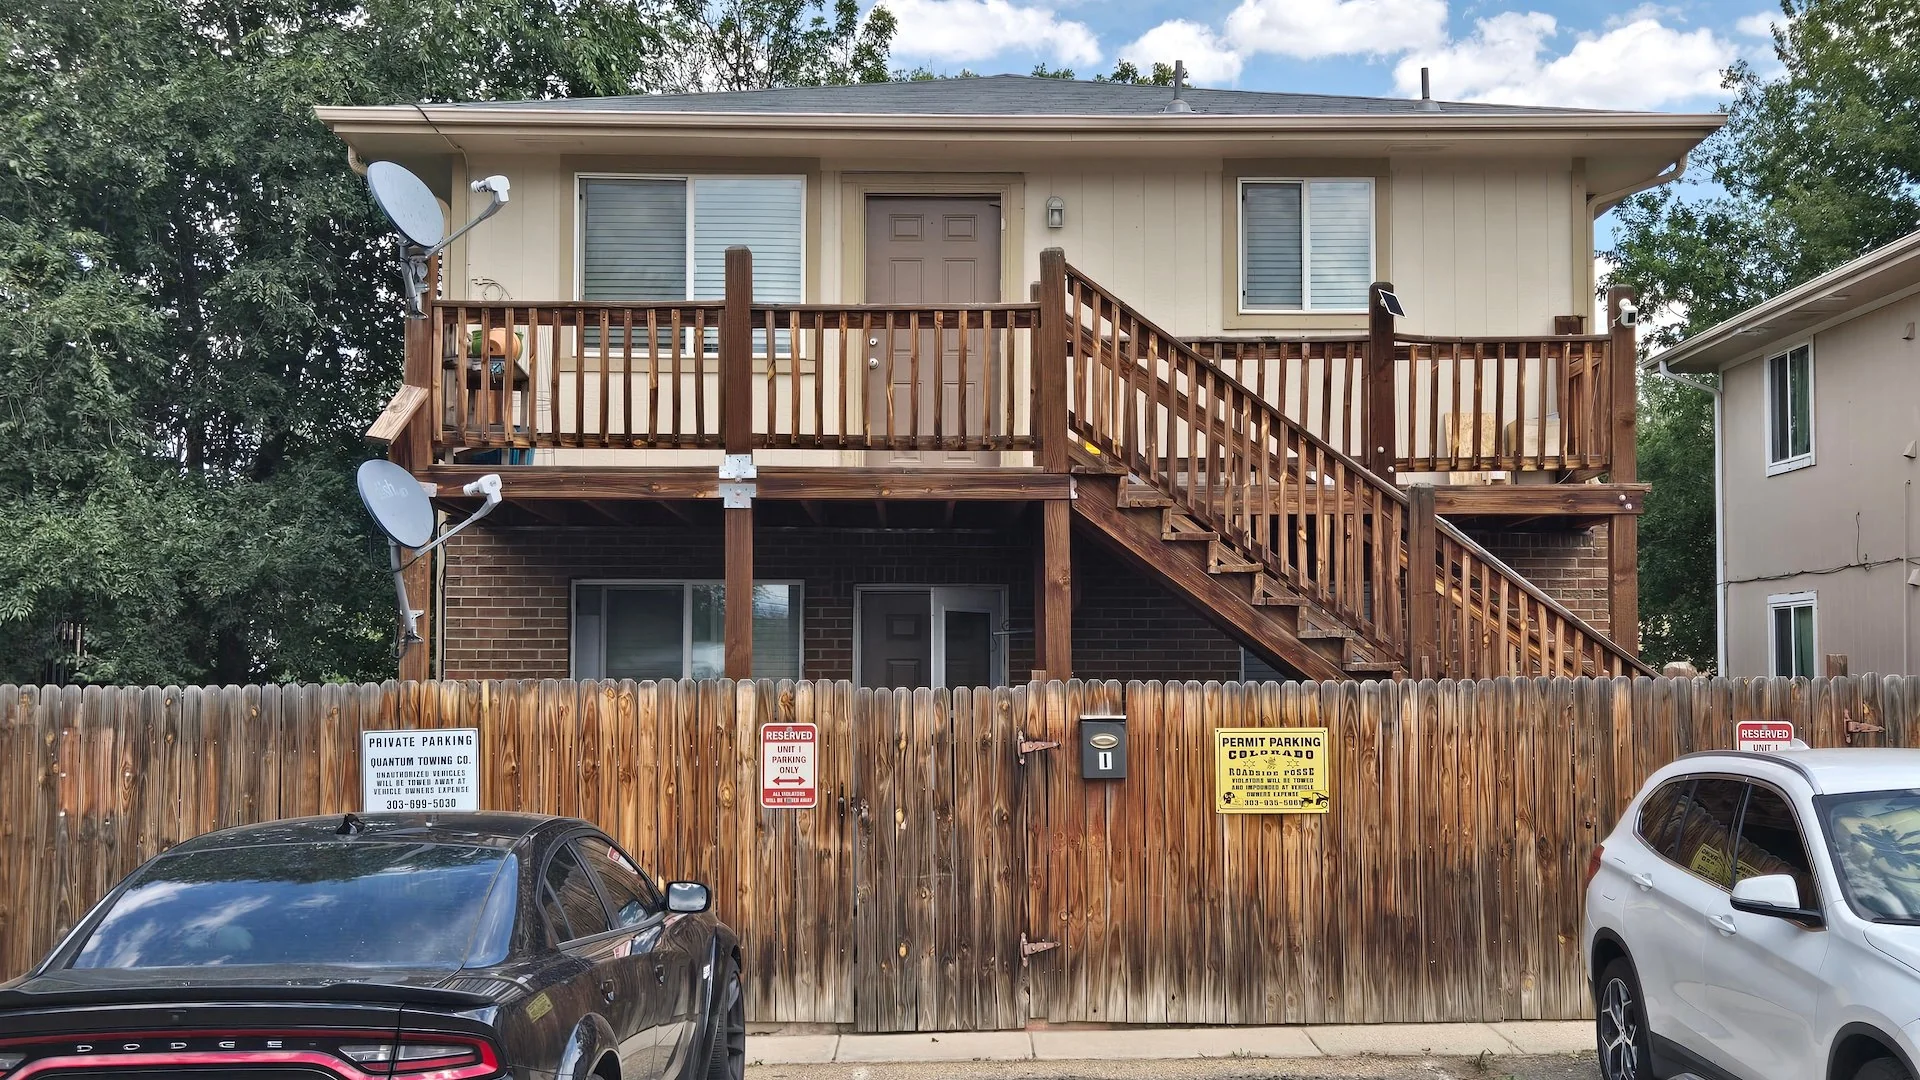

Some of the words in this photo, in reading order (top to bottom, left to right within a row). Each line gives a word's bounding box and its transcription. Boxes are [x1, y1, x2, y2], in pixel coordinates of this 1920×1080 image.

[766, 731, 813, 740] RESERVED
[1741, 729, 1789, 739] RESERVED
[369, 737, 415, 748] PRIVATE
[422, 735, 472, 746] PARKING
[1222, 737, 1266, 747] PERMIT
[1269, 737, 1321, 747] PARKING
[777, 745, 796, 753] UNIT
[1753, 744, 1771, 752] UNIT
[1228, 750, 1314, 759] COLORADO
[370, 757, 414, 768] QUANTUM
[418, 755, 453, 766] TOWING
[456, 755, 472, 765] CO.
[771, 756, 807, 764] PARKING
[376, 770, 429, 778] UNAUTHORIZED
[432, 769, 466, 777] VEHICLES
[779, 766, 800, 774] ONLY
[1229, 768, 1279, 776] ROADSIDE
[1284, 768, 1314, 776] POSSE
[457, 777, 466, 785] AT
[438, 786, 469, 794] EXPENSE
[386, 798, 457, 810] 303-699-5030
[76, 1040, 283, 1053] DODGE
